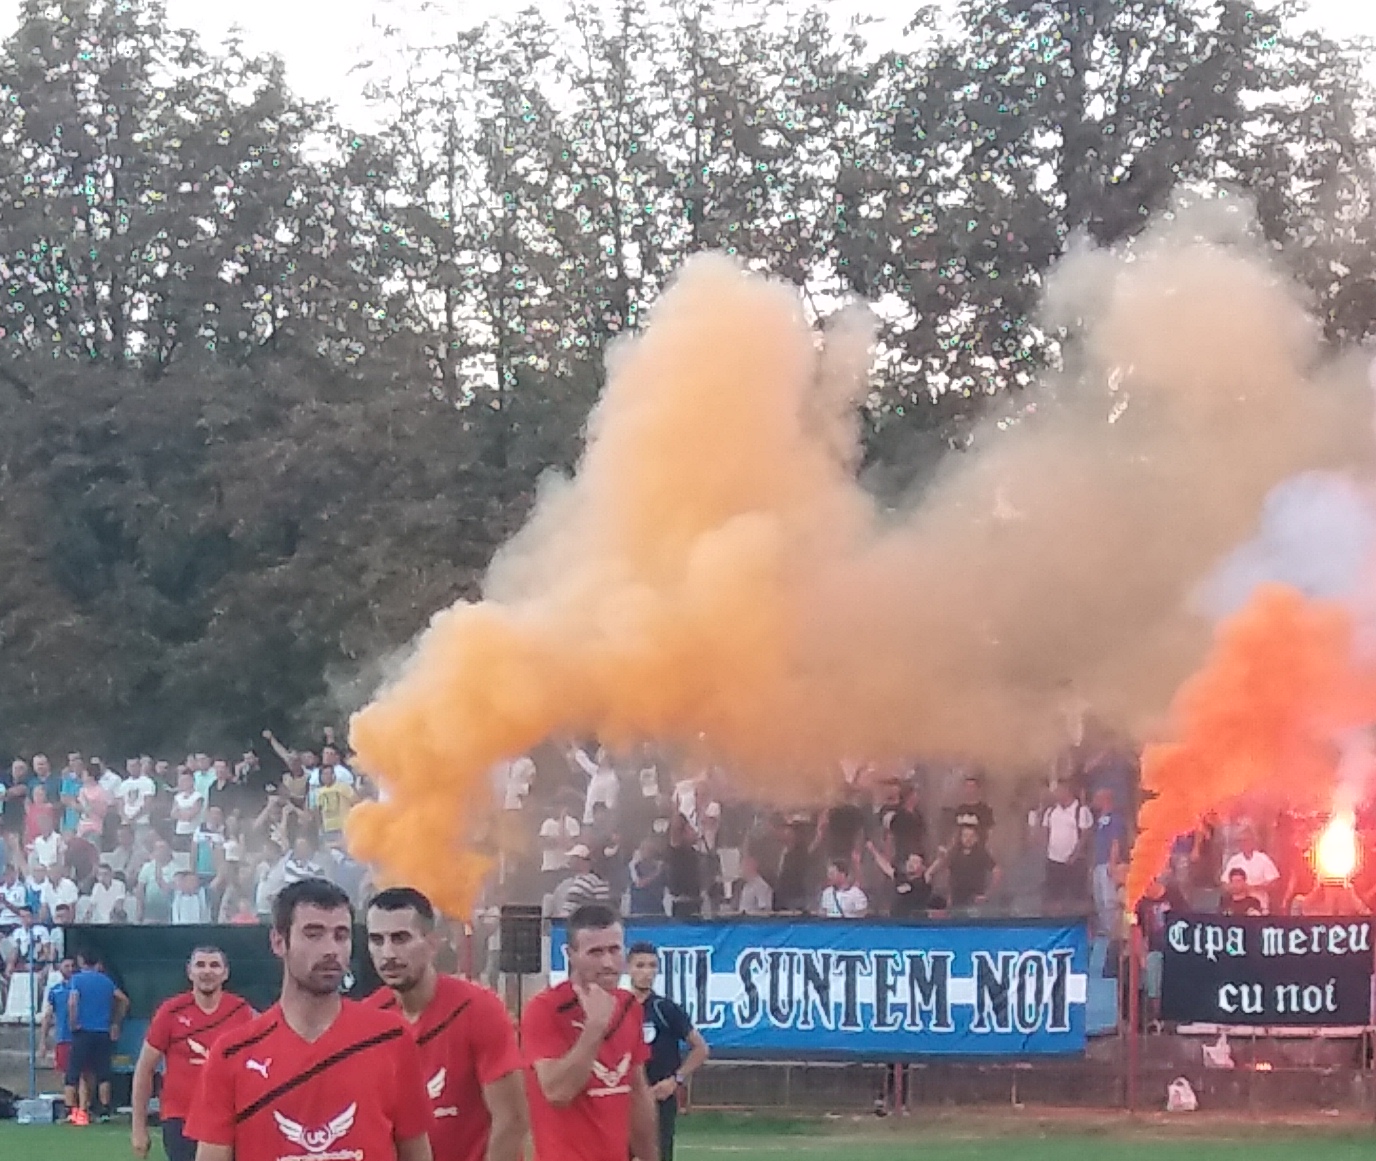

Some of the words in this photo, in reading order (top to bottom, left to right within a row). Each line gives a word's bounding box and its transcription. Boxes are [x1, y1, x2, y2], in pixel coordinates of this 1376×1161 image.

[1168, 920, 1246, 962] Cipa
[1262, 922, 1370, 956] mereu
[736, 944, 954, 1033] SUNTEM
[969, 948, 1076, 1033] NOI
[1218, 982, 1263, 1014] cu
[1276, 978, 1338, 1013] noi
